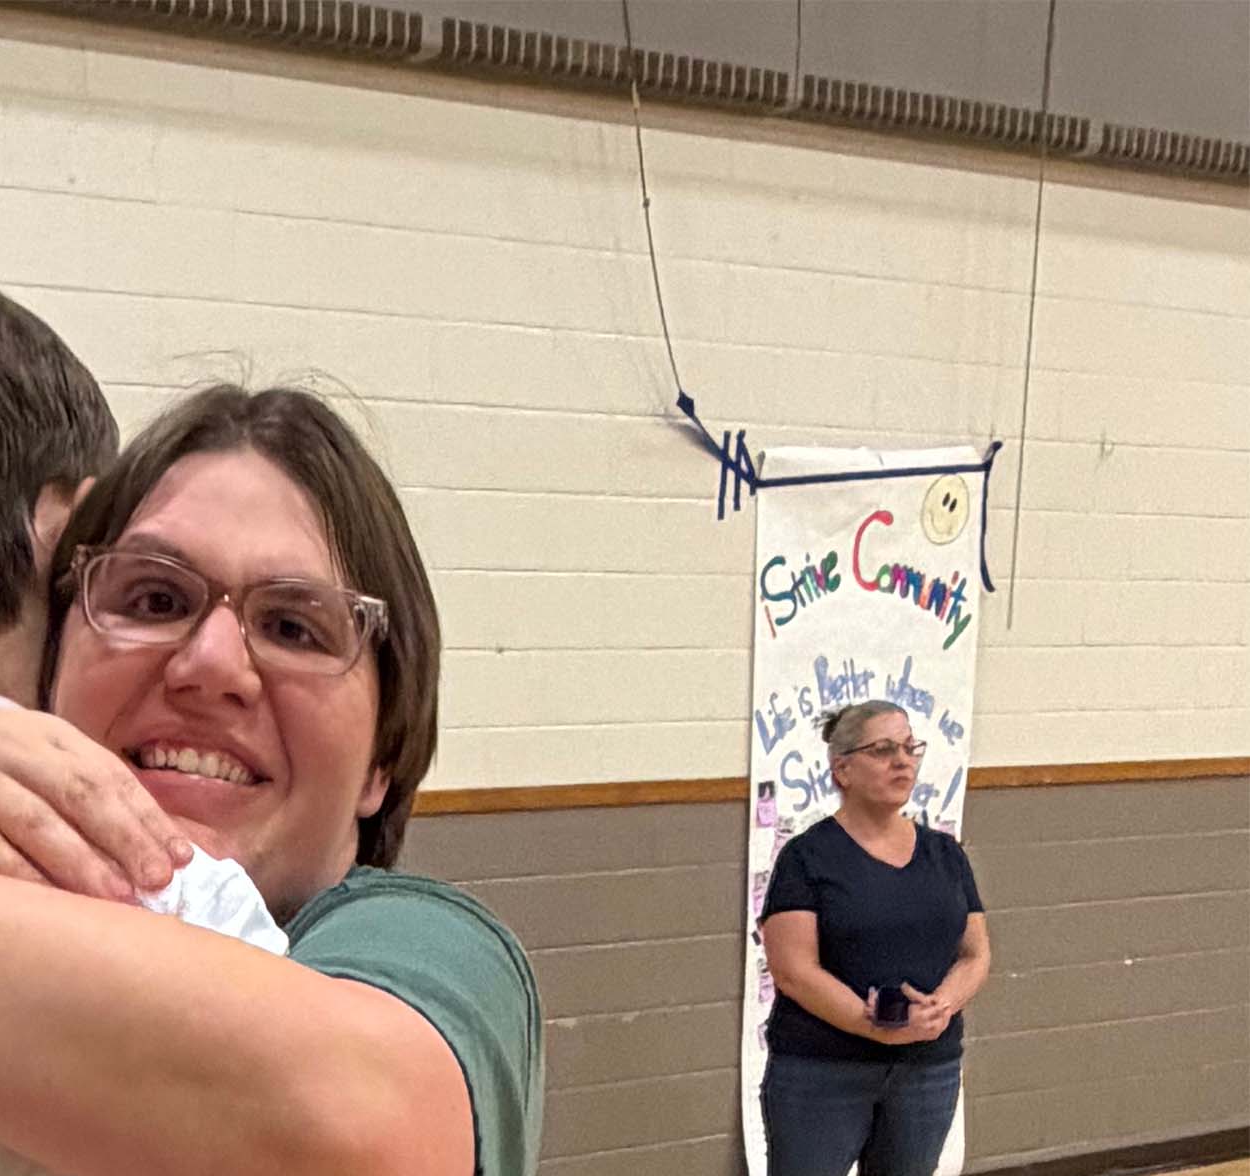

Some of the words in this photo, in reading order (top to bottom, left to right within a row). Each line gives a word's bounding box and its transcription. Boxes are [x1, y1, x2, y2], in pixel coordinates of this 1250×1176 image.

[760, 551, 841, 626] Strive
[853, 510, 972, 650] Community
[755, 691, 797, 755] Life
[793, 683, 814, 718] is
[885, 655, 935, 719] when
[938, 709, 965, 746] we
